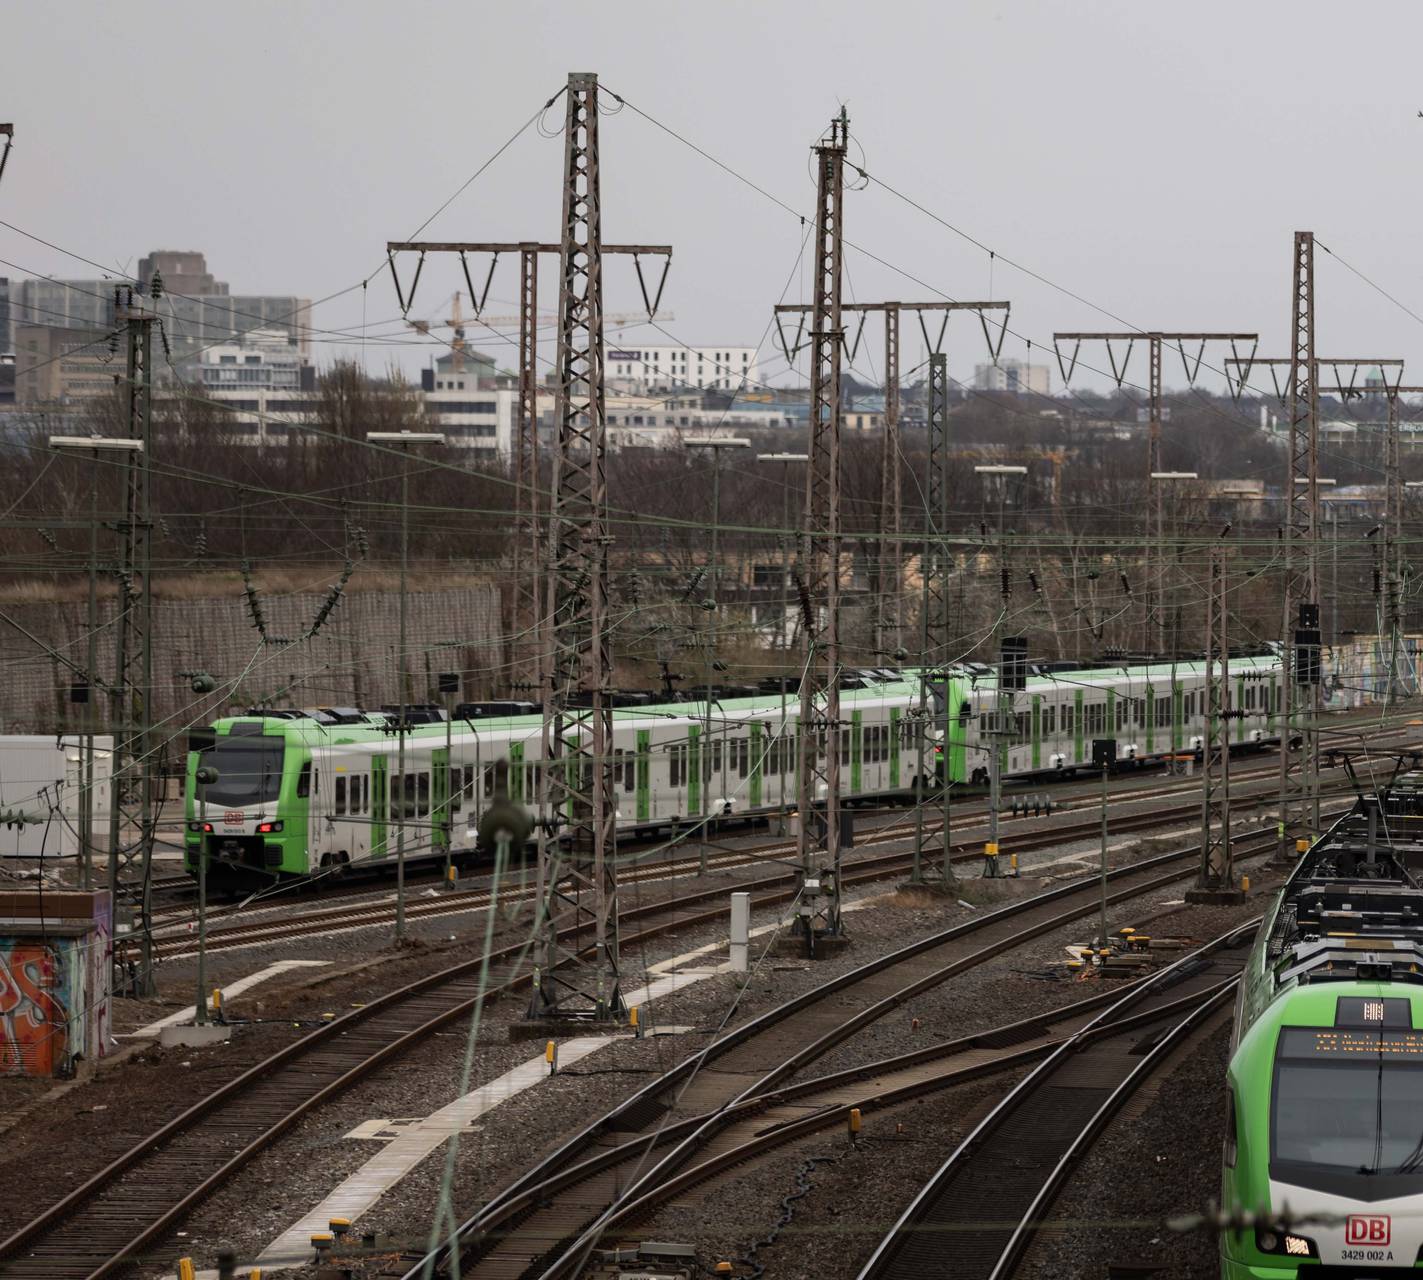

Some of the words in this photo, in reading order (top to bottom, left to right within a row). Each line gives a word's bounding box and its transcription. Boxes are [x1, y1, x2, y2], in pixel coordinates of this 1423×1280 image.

[1350, 1217, 1387, 1242] DB
[1341, 1250, 1365, 1261] 3429
[1366, 1251, 1385, 1261] 002
[1386, 1251, 1394, 1261] A
